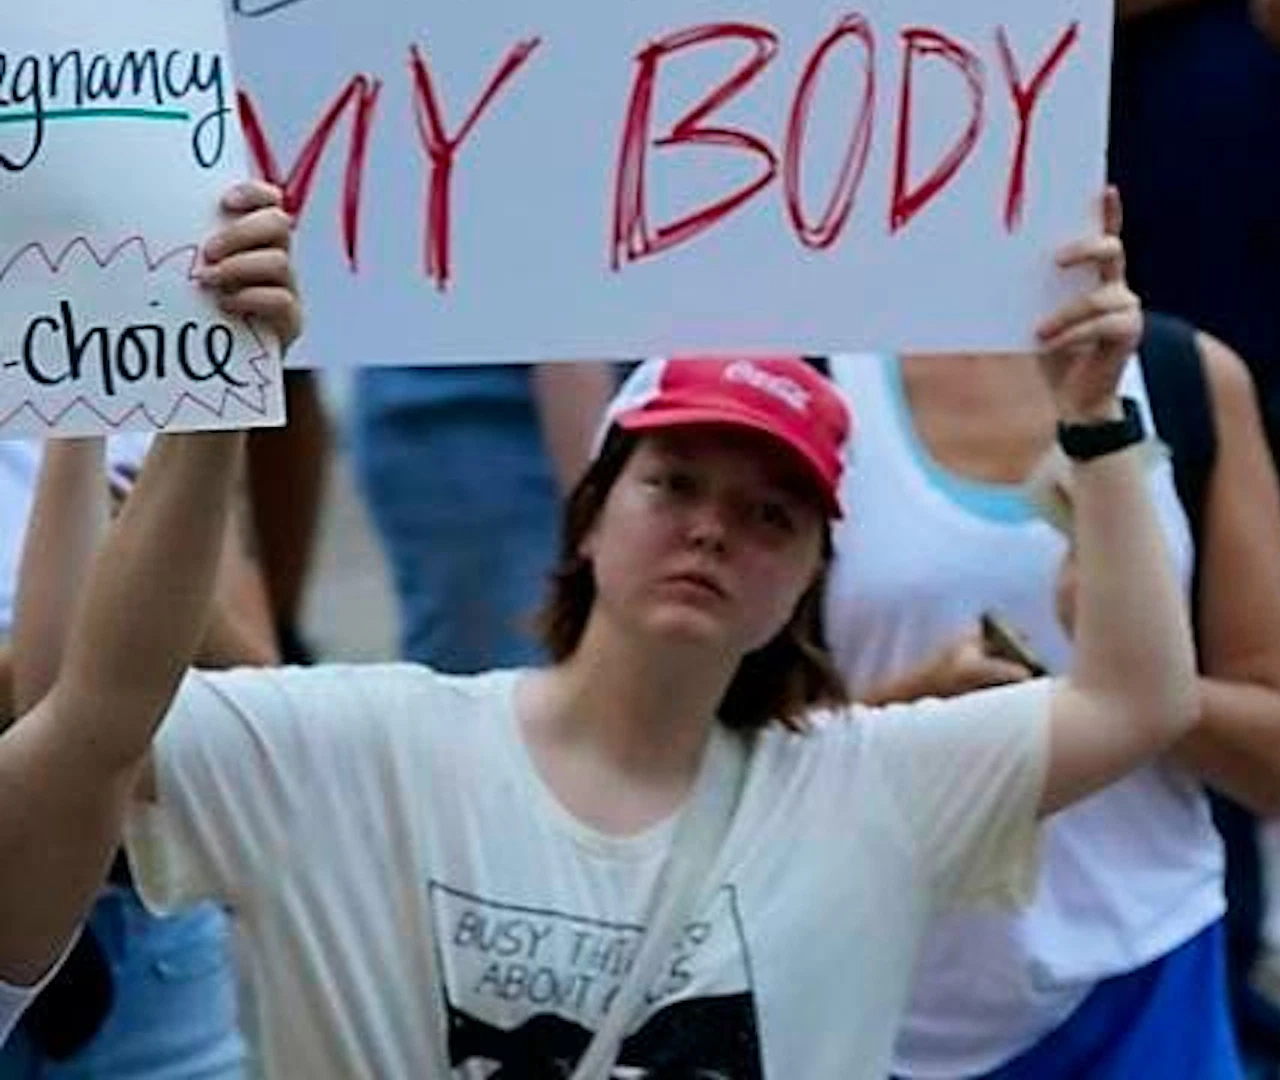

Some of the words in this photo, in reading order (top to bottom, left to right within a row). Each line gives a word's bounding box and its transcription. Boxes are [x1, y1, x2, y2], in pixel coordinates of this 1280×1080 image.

[236, 33, 543, 293] MY
[609, 11, 1082, 273] BODY
[454, 912, 552, 961] BUSY
